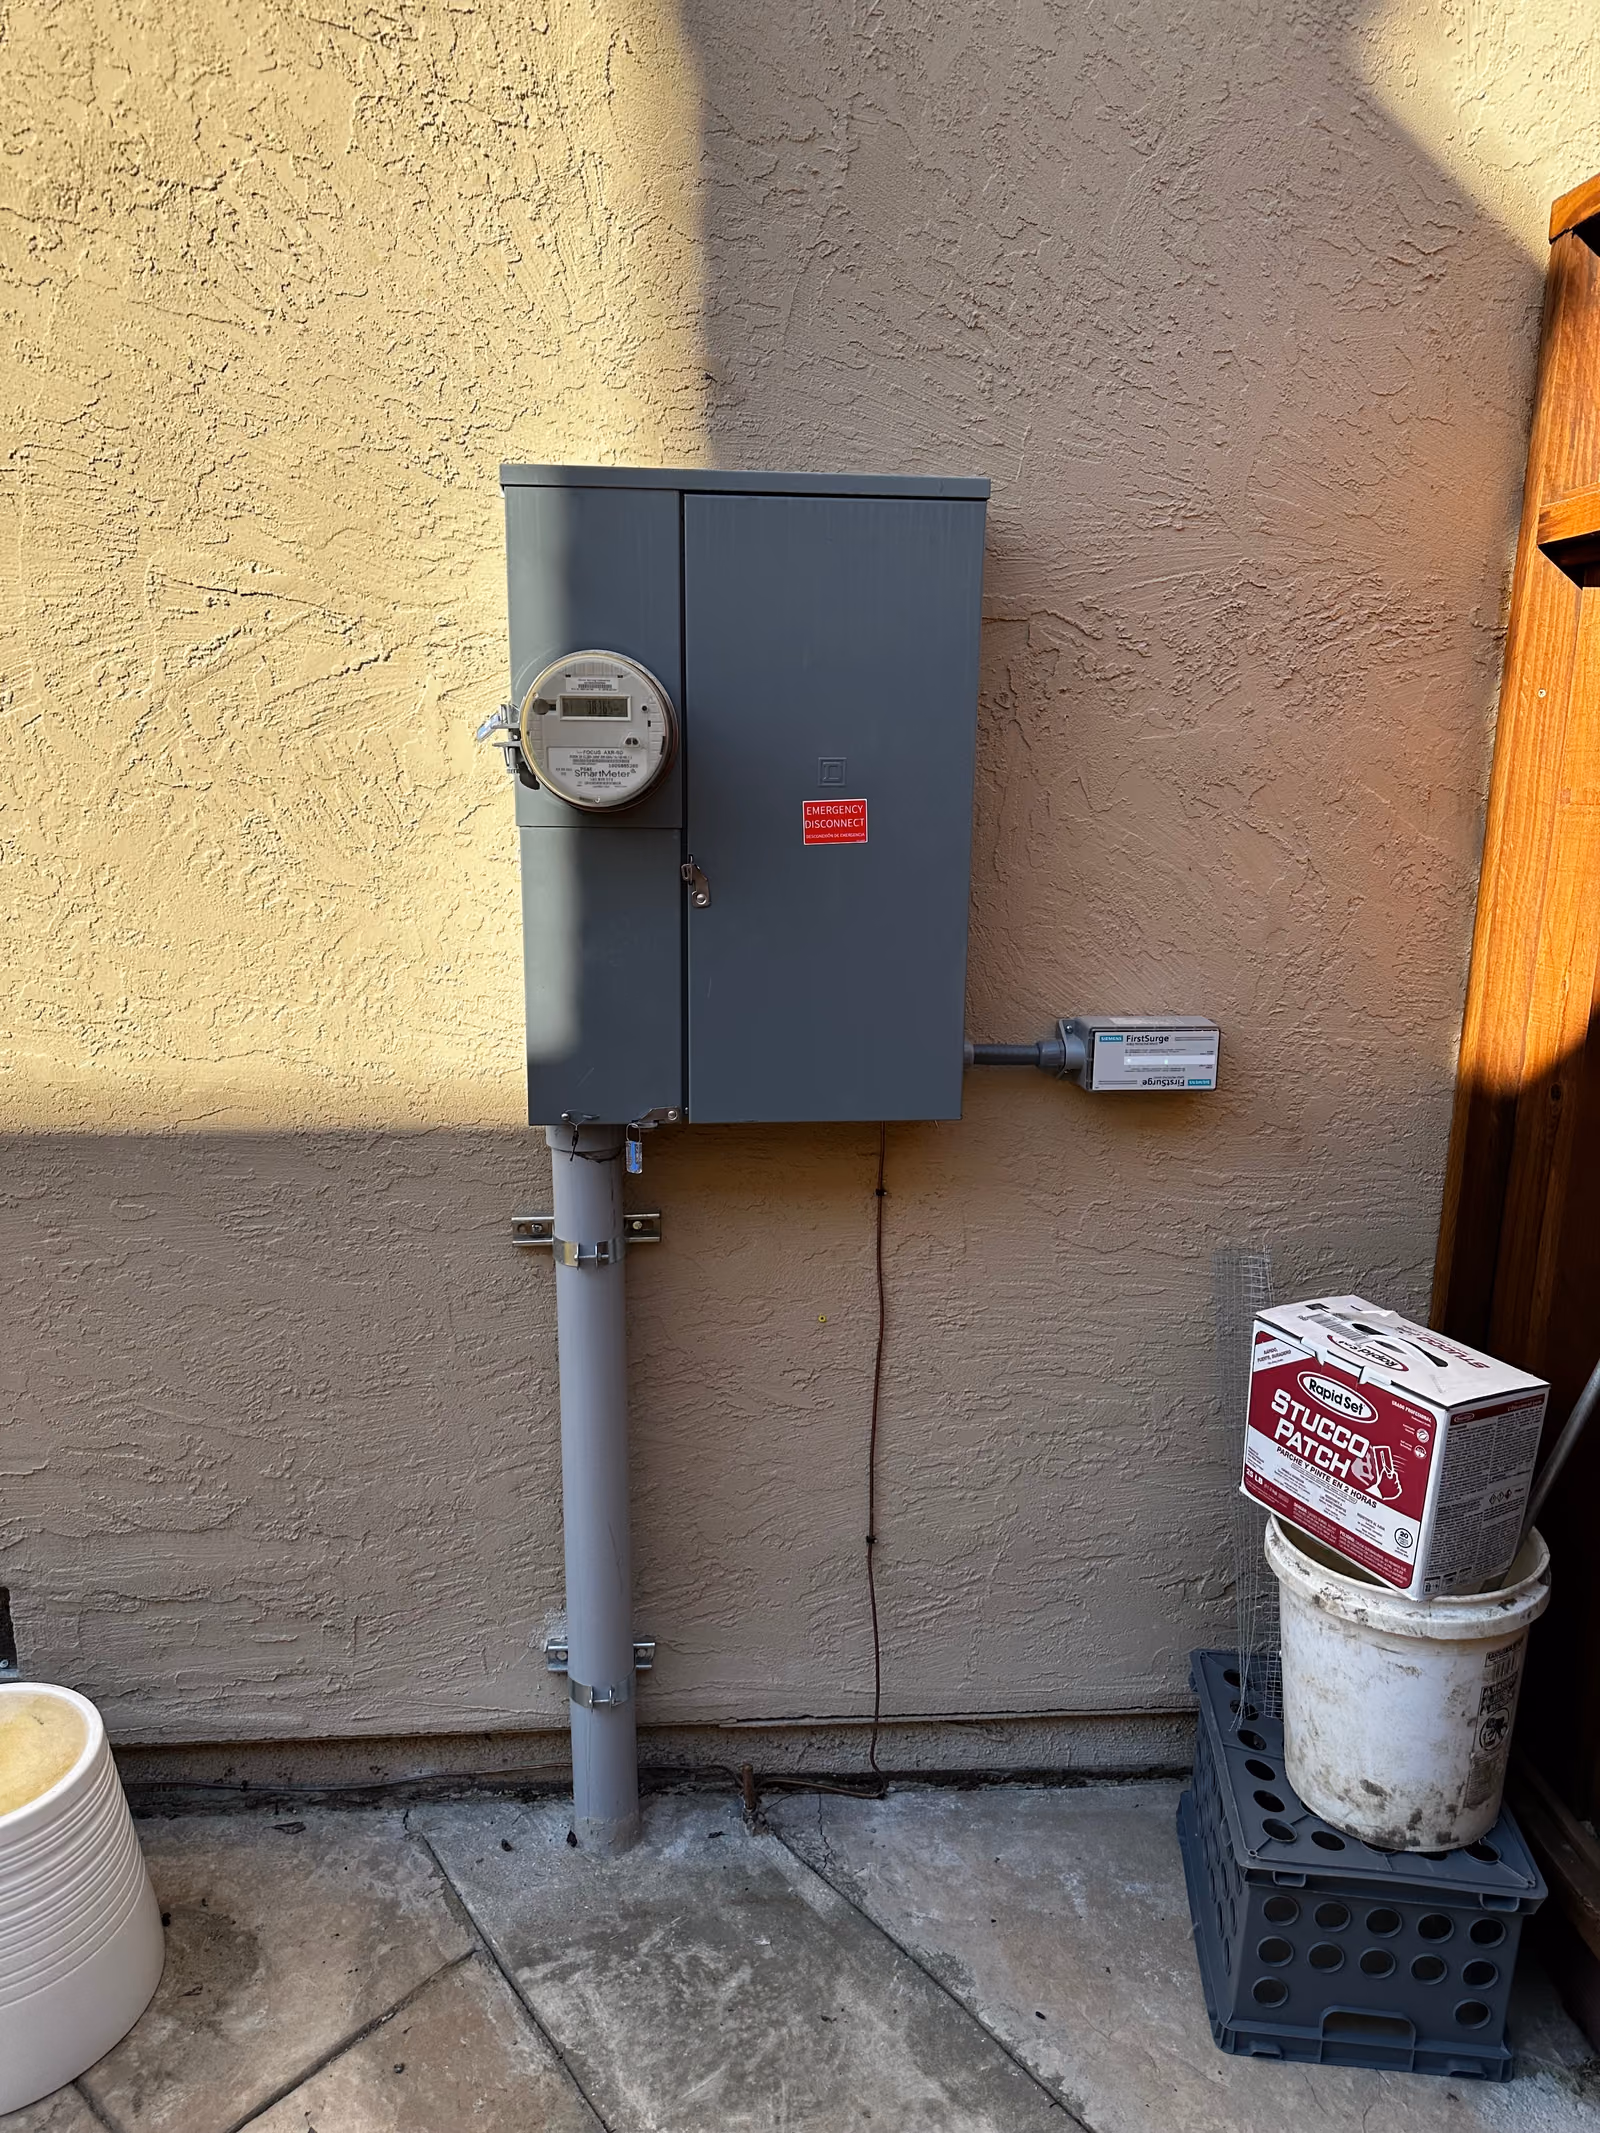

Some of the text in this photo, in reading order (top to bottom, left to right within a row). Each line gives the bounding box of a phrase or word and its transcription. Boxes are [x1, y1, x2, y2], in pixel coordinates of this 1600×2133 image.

[574, 769, 630, 778] SmartMeter
[806, 804, 864, 816] EMERGENCY
[804, 818, 865, 829] DISCONNECT
[1126, 1034, 1169, 1044] FirstSurge
[1142, 1077, 1185, 1087] FirstSurge
[1357, 1349, 1399, 1368] Rapid
[1417, 1336, 1491, 1370] STUCCO
[1308, 1378, 1364, 1416] Rapid Set
[1271, 1388, 1370, 1459] STUCCO
[1274, 1417, 1351, 1479] PATCH
[1246, 1468, 1254, 1478] 25
[1254, 1472, 1263, 1485] LB
[1276, 1446, 1303, 1467] PARCHE
[1304, 1462, 1310, 1470] Y
[1310, 1466, 1332, 1483] PINTE
[1332, 1479, 1343, 1490] EN
[1343, 1485, 1349, 1493] 2
[1350, 1488, 1378, 1509] HORAS
[1399, 1531, 1409, 1539] 20
